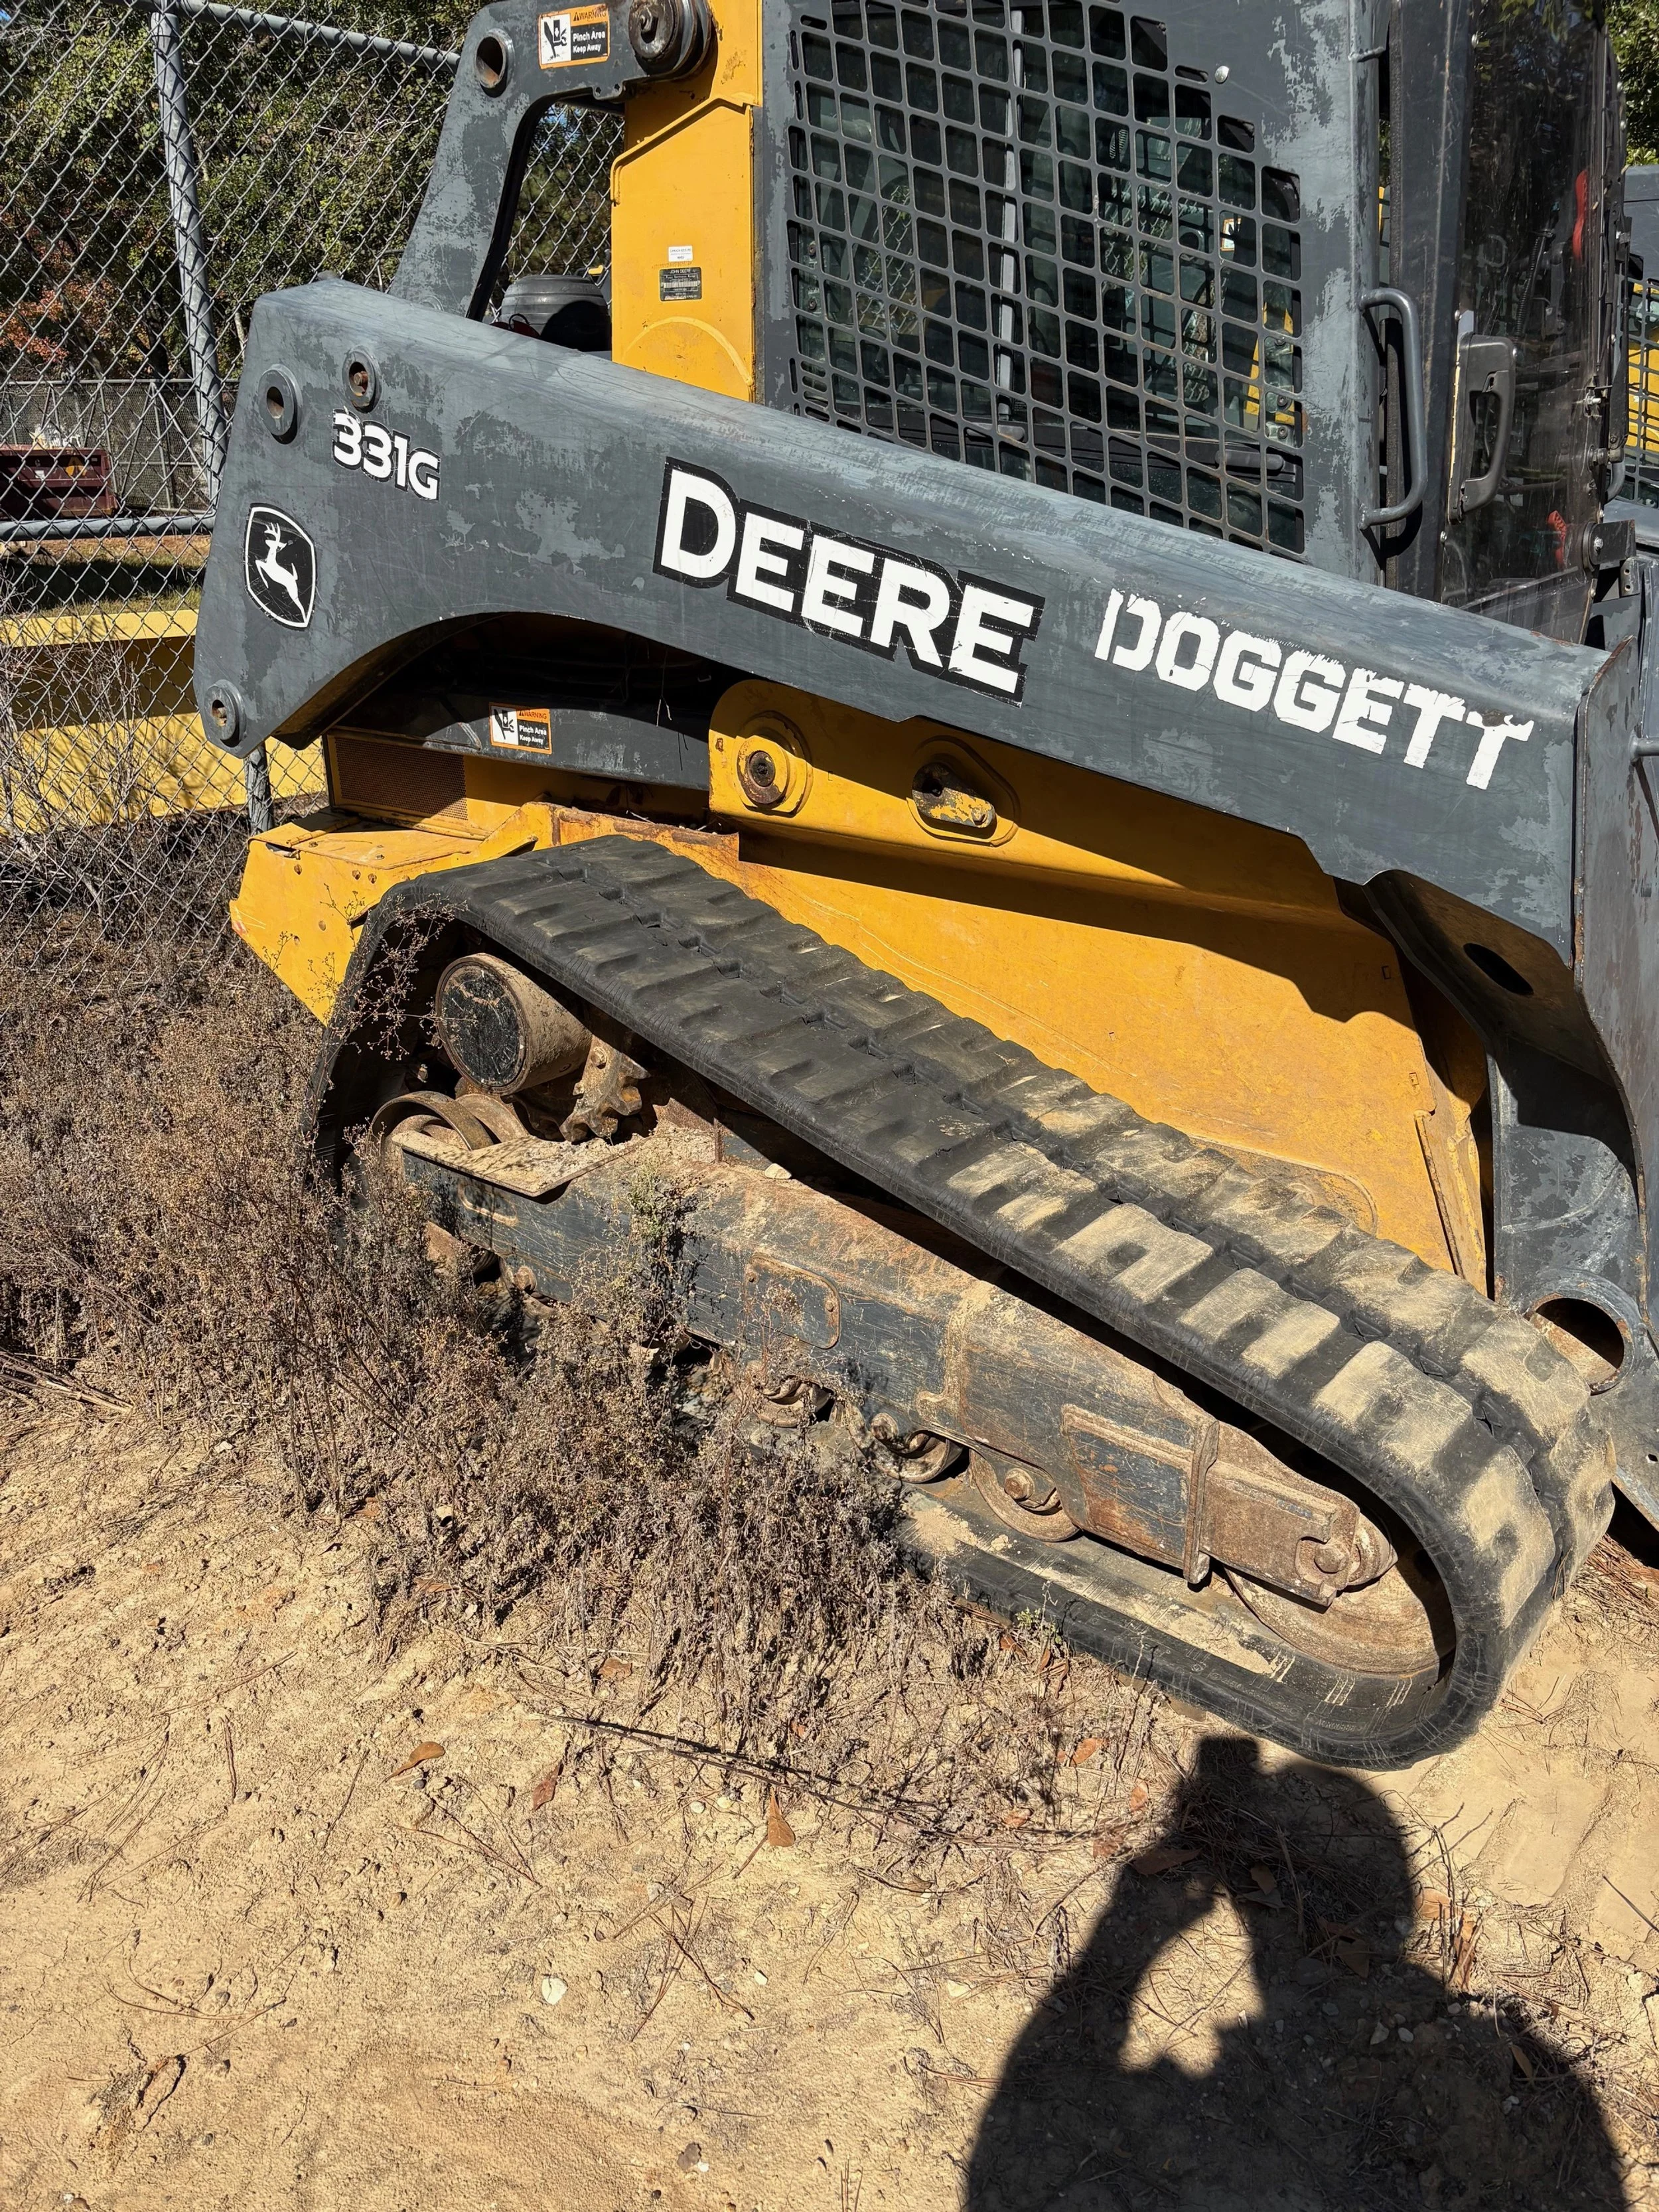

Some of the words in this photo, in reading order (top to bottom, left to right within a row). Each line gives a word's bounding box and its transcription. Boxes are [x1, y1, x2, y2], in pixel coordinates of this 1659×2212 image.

[579, 9, 607, 21] WARNING
[573, 31, 590, 42] Pinch
[591, 31, 605, 40] Area
[573, 44, 587, 54] Keep
[587, 44, 601, 52] Away
[332, 410, 439, 500] 331G
[659, 467, 1035, 695] DEERE
[1094, 587, 1534, 790] DOGGETT
[524, 710, 547, 719] WARNING
[519, 725, 534, 733] Pinch
[520, 734, 531, 743] Keep
[532, 736, 543, 745] Away
